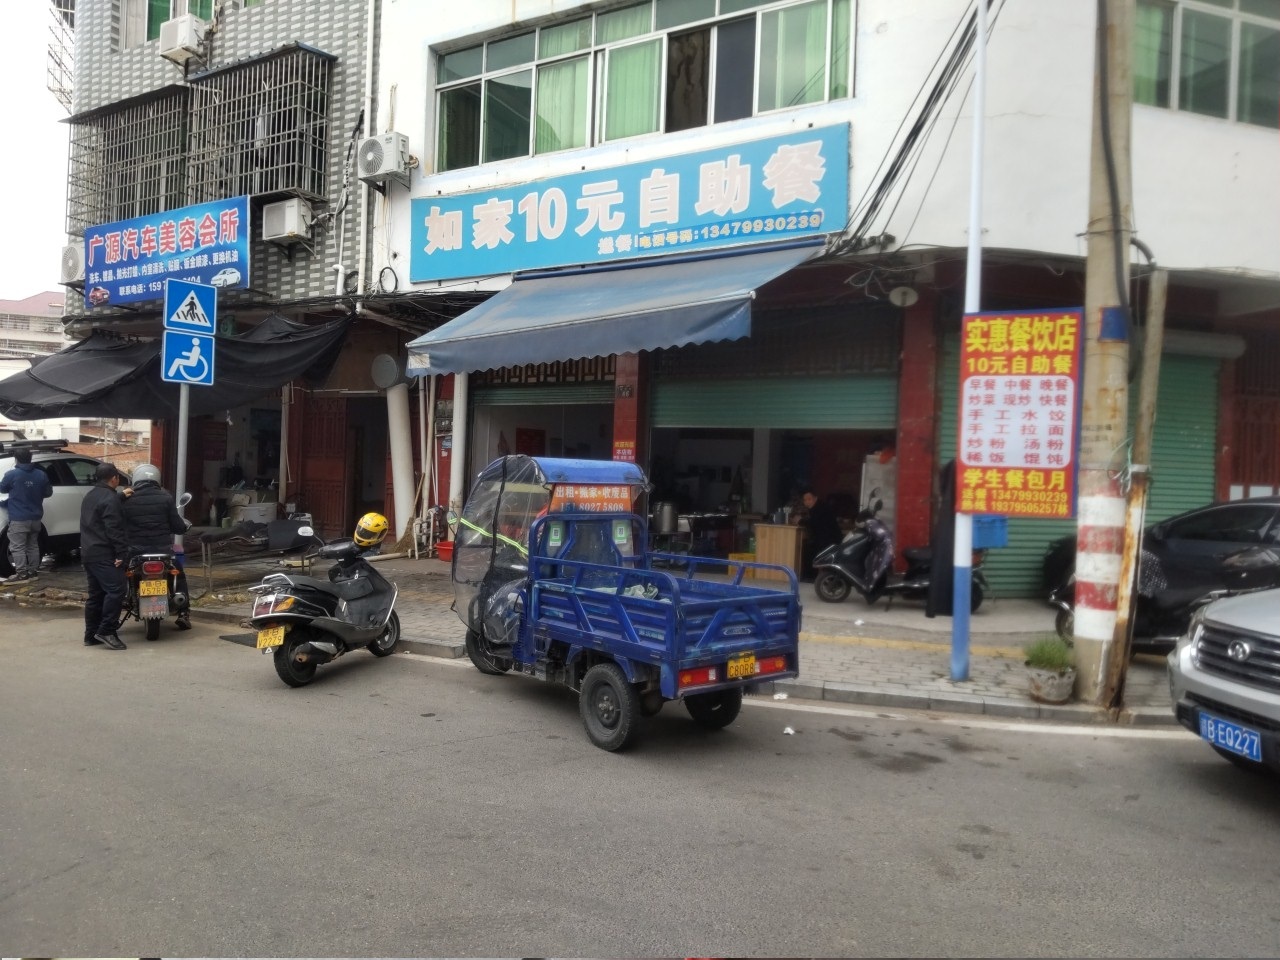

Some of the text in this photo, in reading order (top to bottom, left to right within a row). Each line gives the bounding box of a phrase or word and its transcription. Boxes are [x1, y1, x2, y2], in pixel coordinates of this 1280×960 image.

[424, 139, 827, 256] 如家10元自助餐
[88, 207, 239, 267] 广源汽车美容会所
[965, 315, 1077, 353] 实惠餐饮店
[966, 355, 1072, 374] 10元自助餐
[970, 379, 996, 391] 早餐
[1004, 379, 1032, 391] 中餐
[964, 468, 1065, 490] 学生餐包月
[991, 488, 1068, 502] 13479930239
